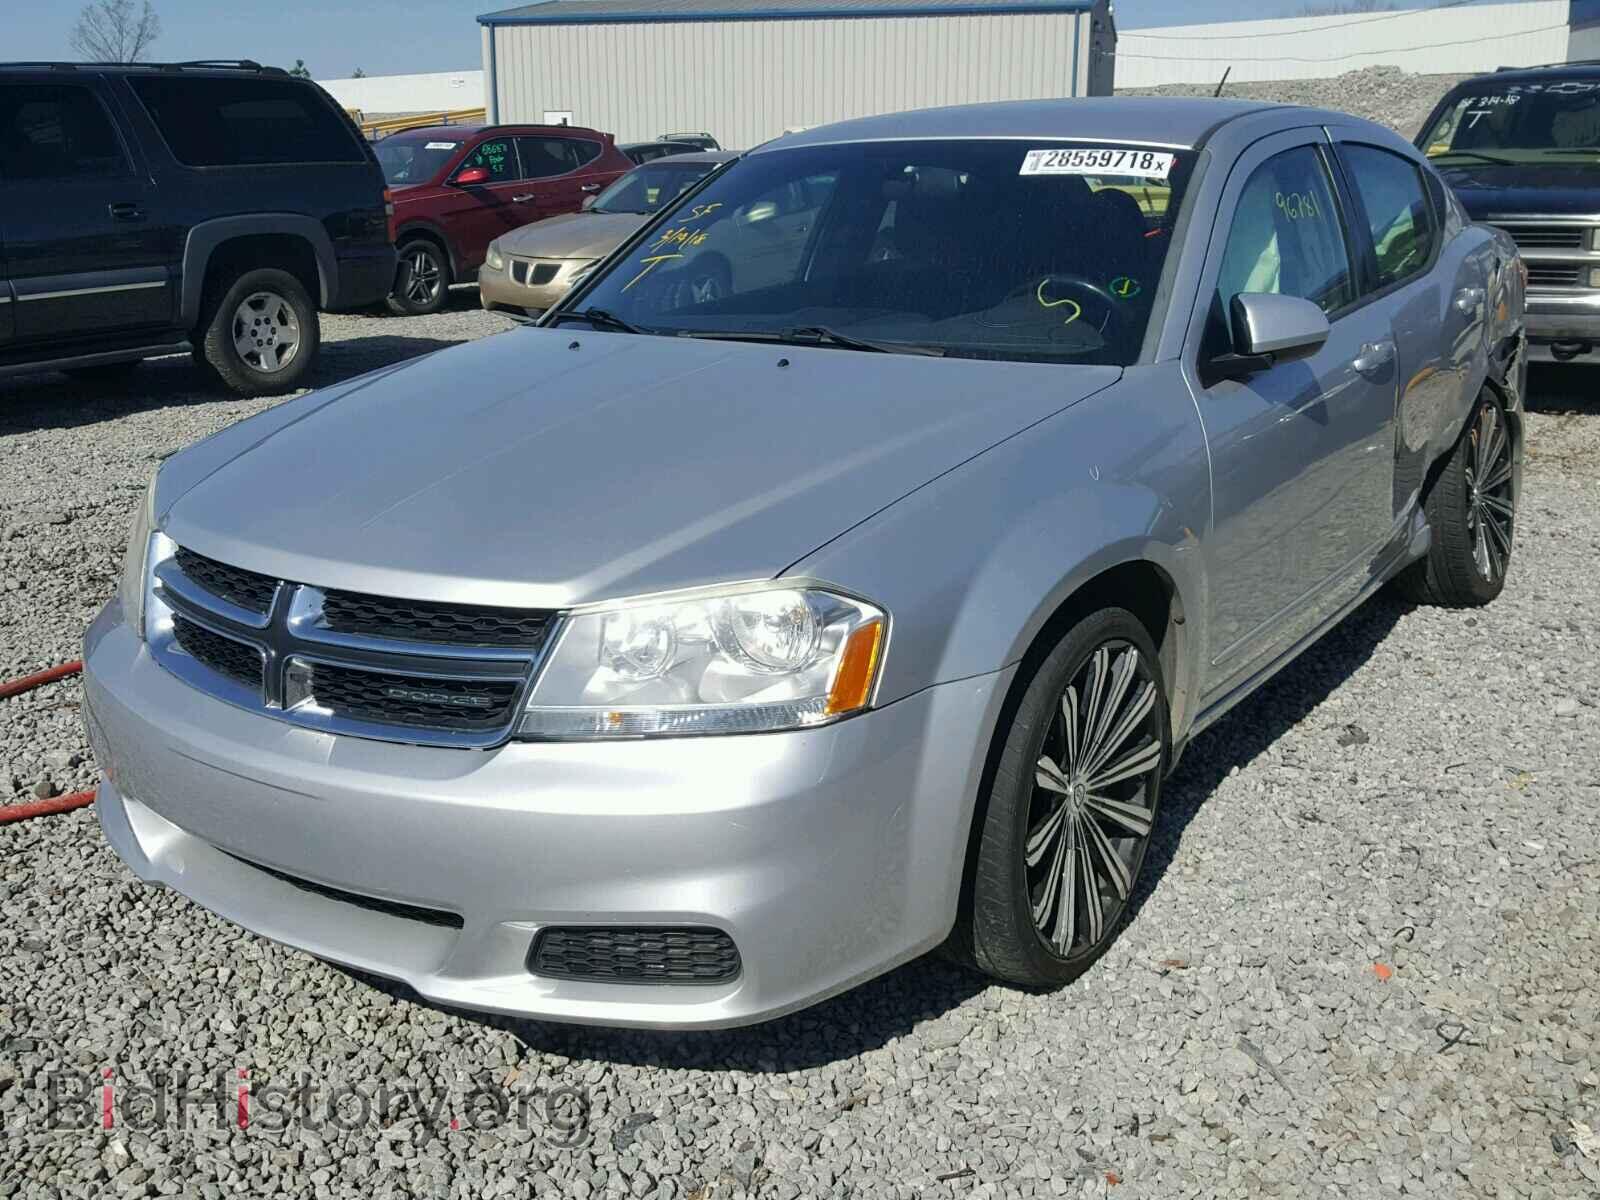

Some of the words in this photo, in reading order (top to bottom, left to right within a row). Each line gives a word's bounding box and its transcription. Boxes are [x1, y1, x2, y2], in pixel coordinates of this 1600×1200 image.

[1467, 110, 1493, 129] T
[619, 253, 684, 294] T
[1037, 278, 1081, 324] S
[387, 687, 492, 707] DODGE
